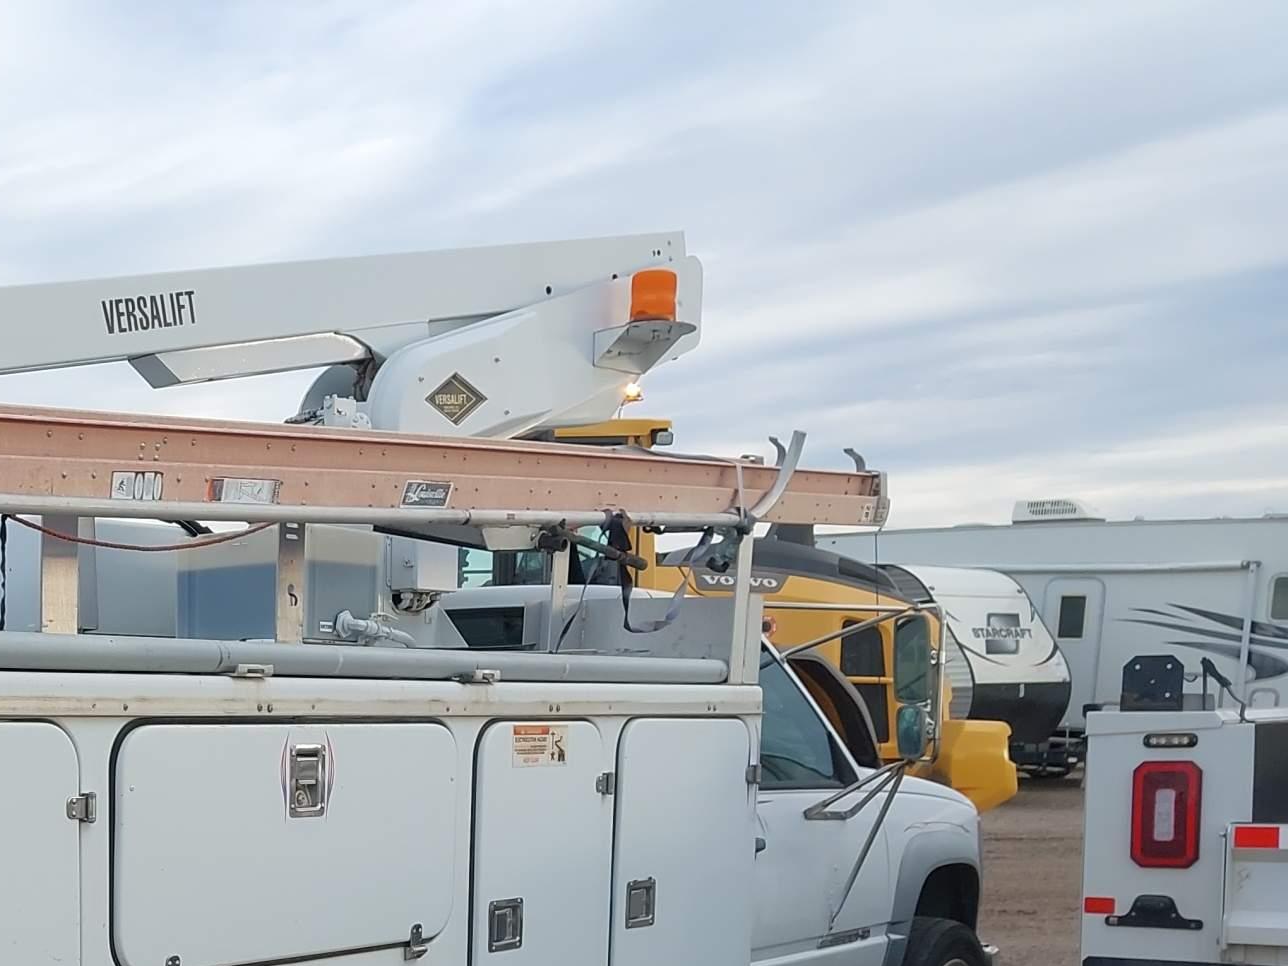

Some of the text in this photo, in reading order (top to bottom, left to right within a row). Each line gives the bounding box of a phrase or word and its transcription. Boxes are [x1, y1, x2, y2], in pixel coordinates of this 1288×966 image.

[101, 290, 195, 335] VERSALIFT
[434, 393, 467, 405] VERSALIFT
[701, 574, 778, 588] VOVO
[971, 627, 1033, 639] STARCRAFT
